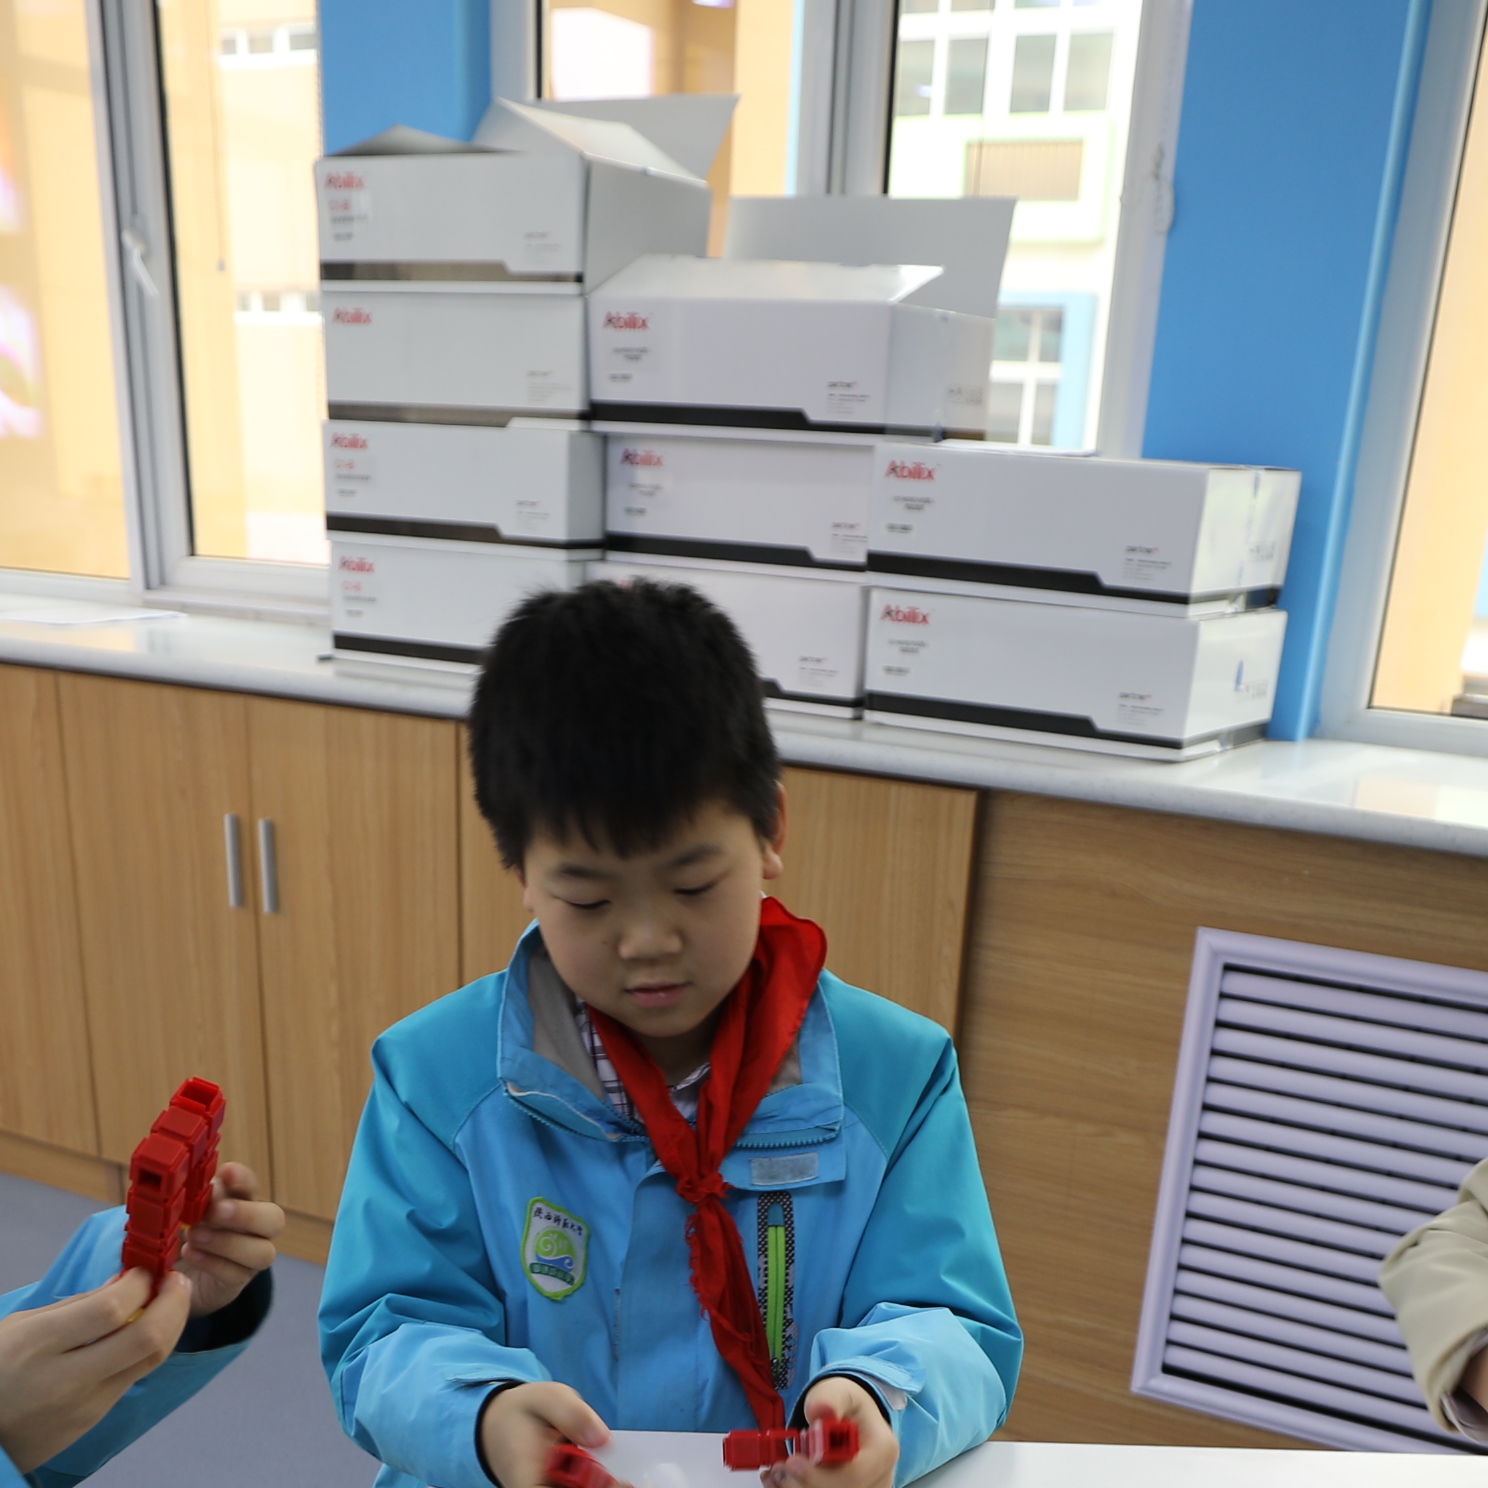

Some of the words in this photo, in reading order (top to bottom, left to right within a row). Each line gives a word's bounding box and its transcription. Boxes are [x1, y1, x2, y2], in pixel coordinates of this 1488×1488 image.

[602, 311, 650, 331] Abilix
[620, 448, 663, 467] Abilix
[884, 460, 936, 481] Abilix
[880, 604, 930, 625] Abilix
